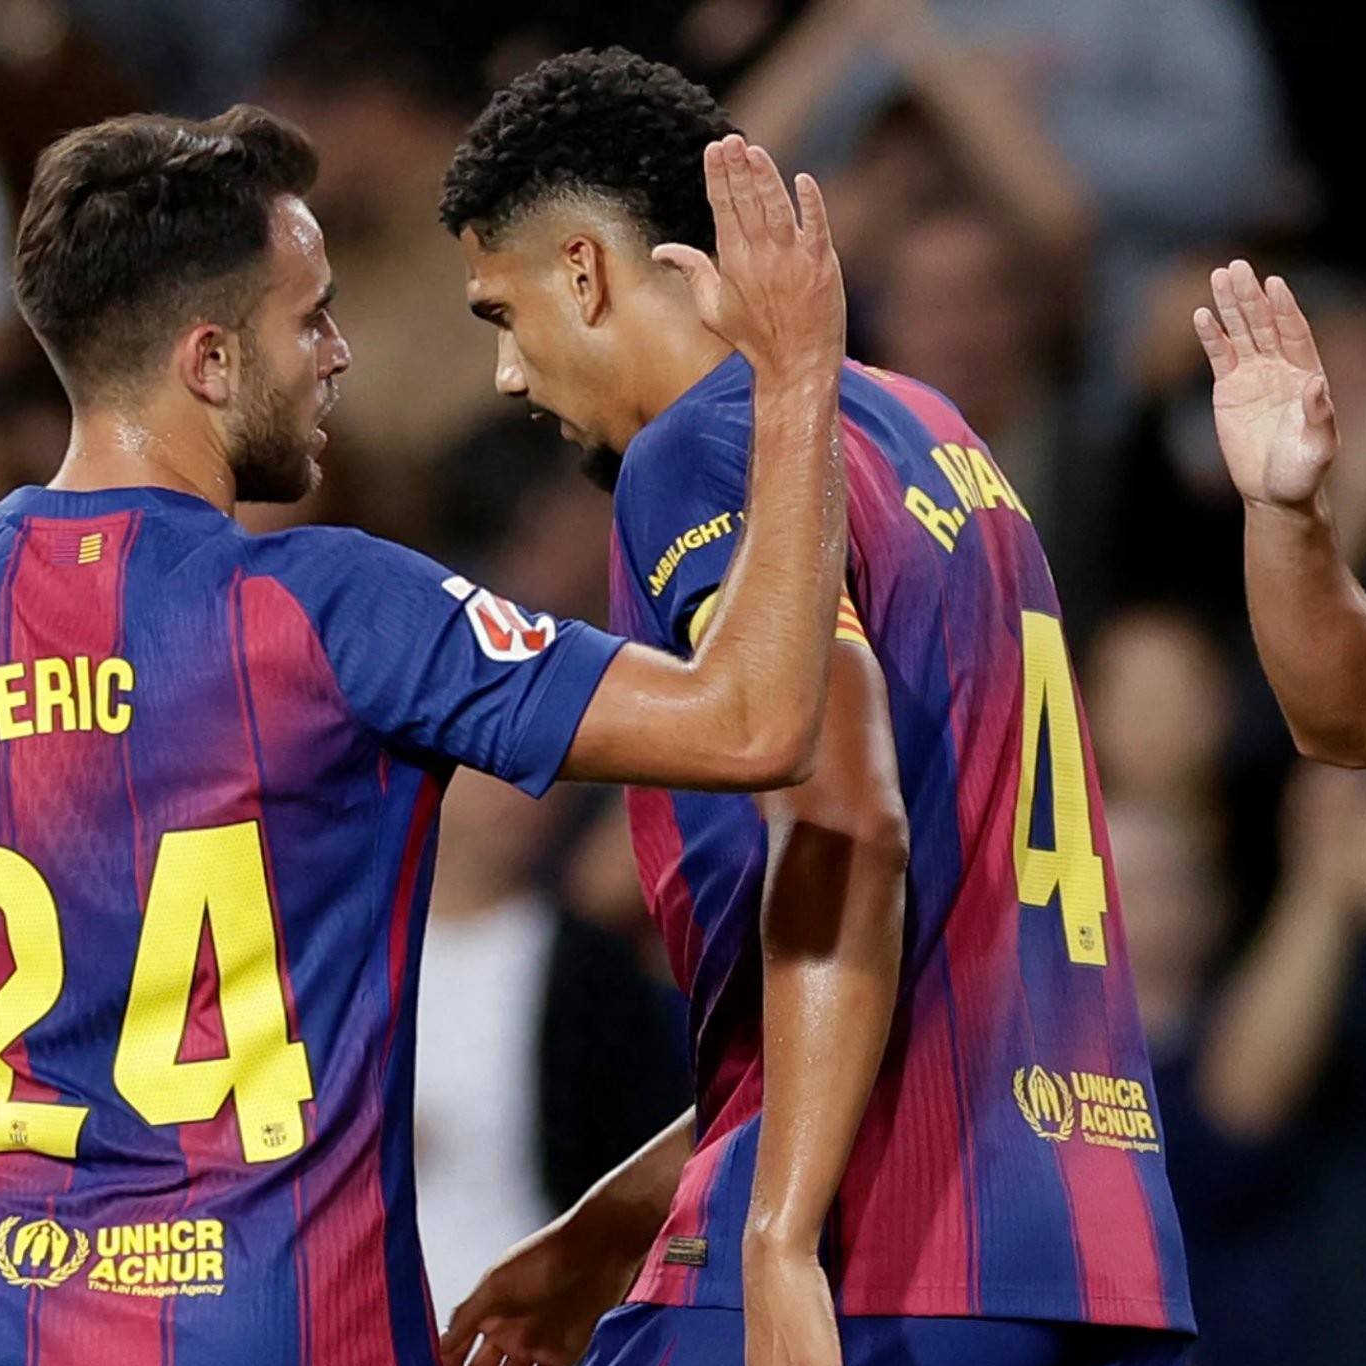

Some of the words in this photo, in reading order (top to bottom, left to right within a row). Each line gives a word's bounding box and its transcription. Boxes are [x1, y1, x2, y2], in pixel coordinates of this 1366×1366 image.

[1013, 610, 1108, 966] 4
[1070, 1070, 1148, 1110] UNHCR
[1081, 1102, 1157, 1139] ACNUR
[97, 1218, 225, 1257] UNHCR
[88, 1250, 224, 1285] ACNUR
[88, 1279, 110, 1292] The
[132, 1284, 179, 1299] Refugee
[180, 1283, 224, 1296] Agency
